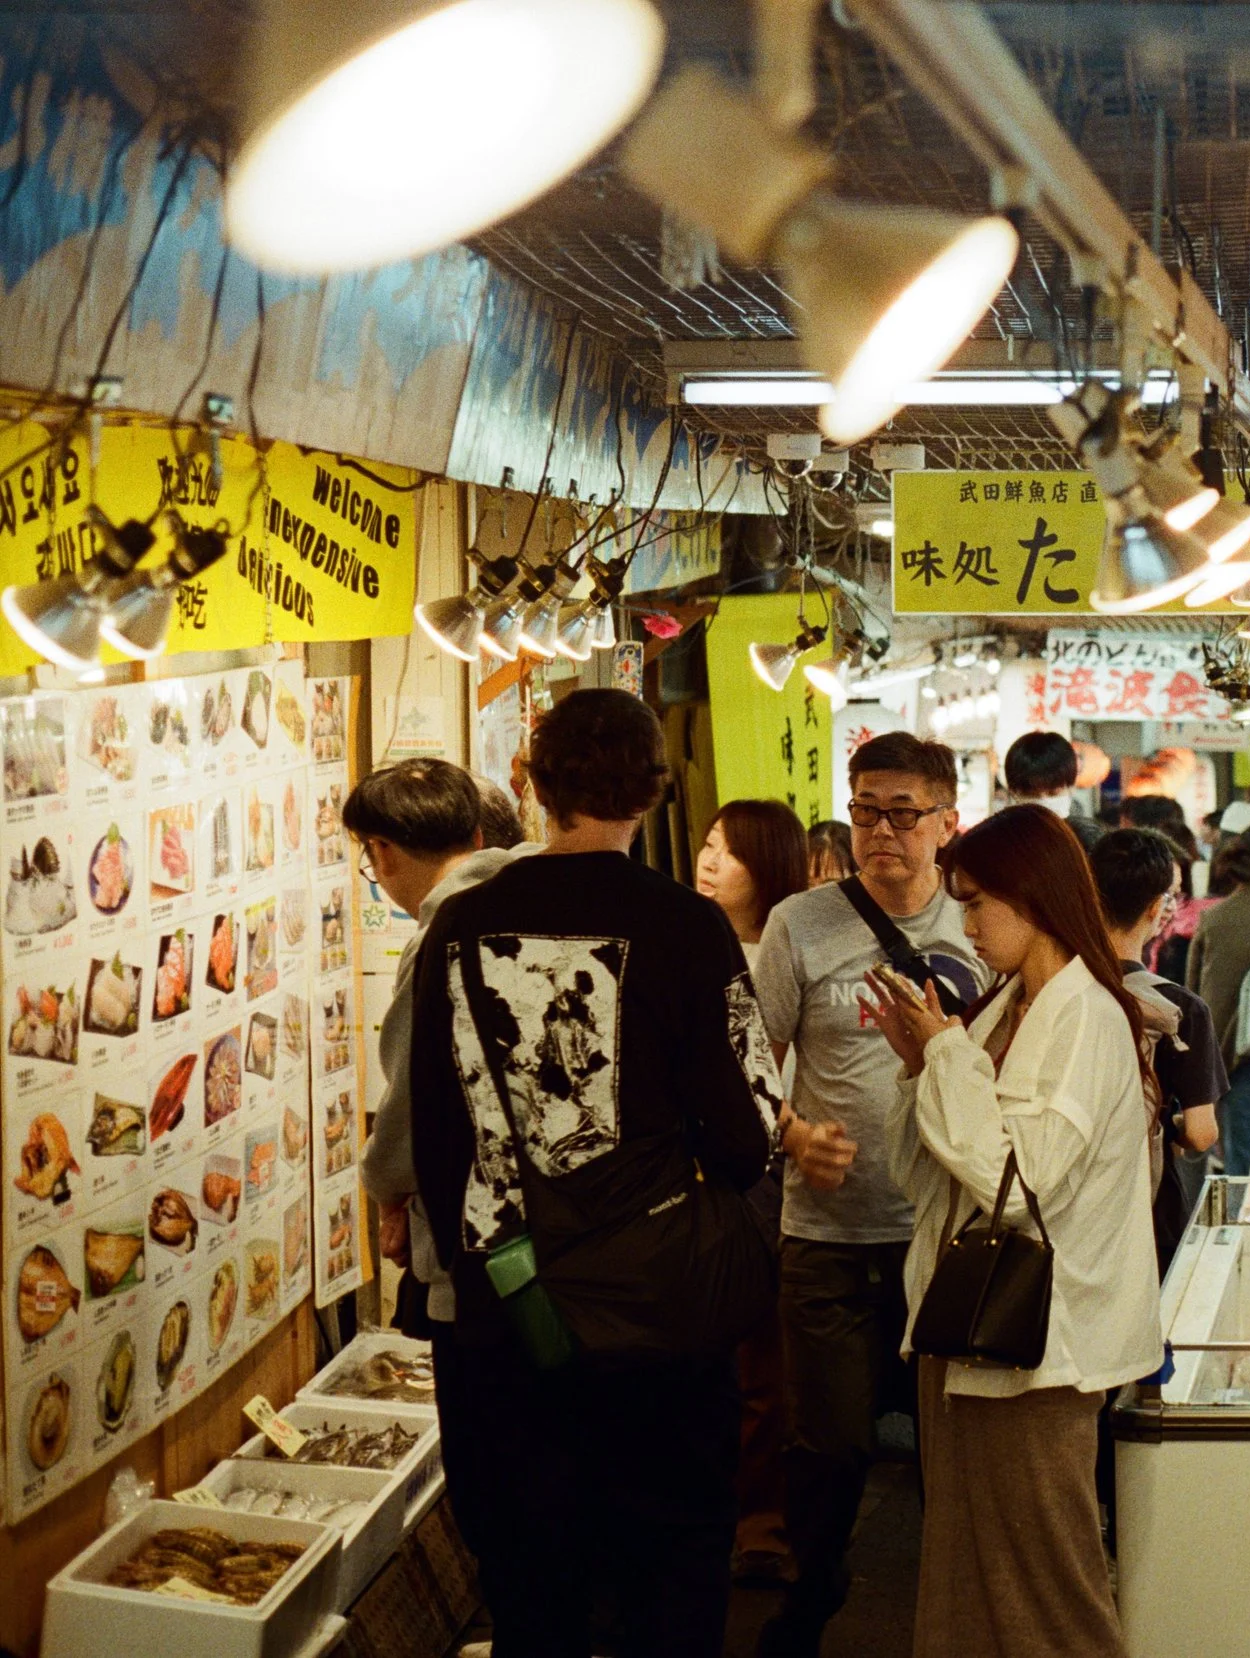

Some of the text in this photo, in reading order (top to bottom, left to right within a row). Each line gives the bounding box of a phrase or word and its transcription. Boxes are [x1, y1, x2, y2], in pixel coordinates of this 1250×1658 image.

[313, 464, 401, 549] welcome
[959, 479, 1069, 504] 武田鮮魚店
[238, 535, 314, 627] delicious
[901, 515, 1080, 604] 味処 た
[1049, 667, 1233, 721] 滝波食
